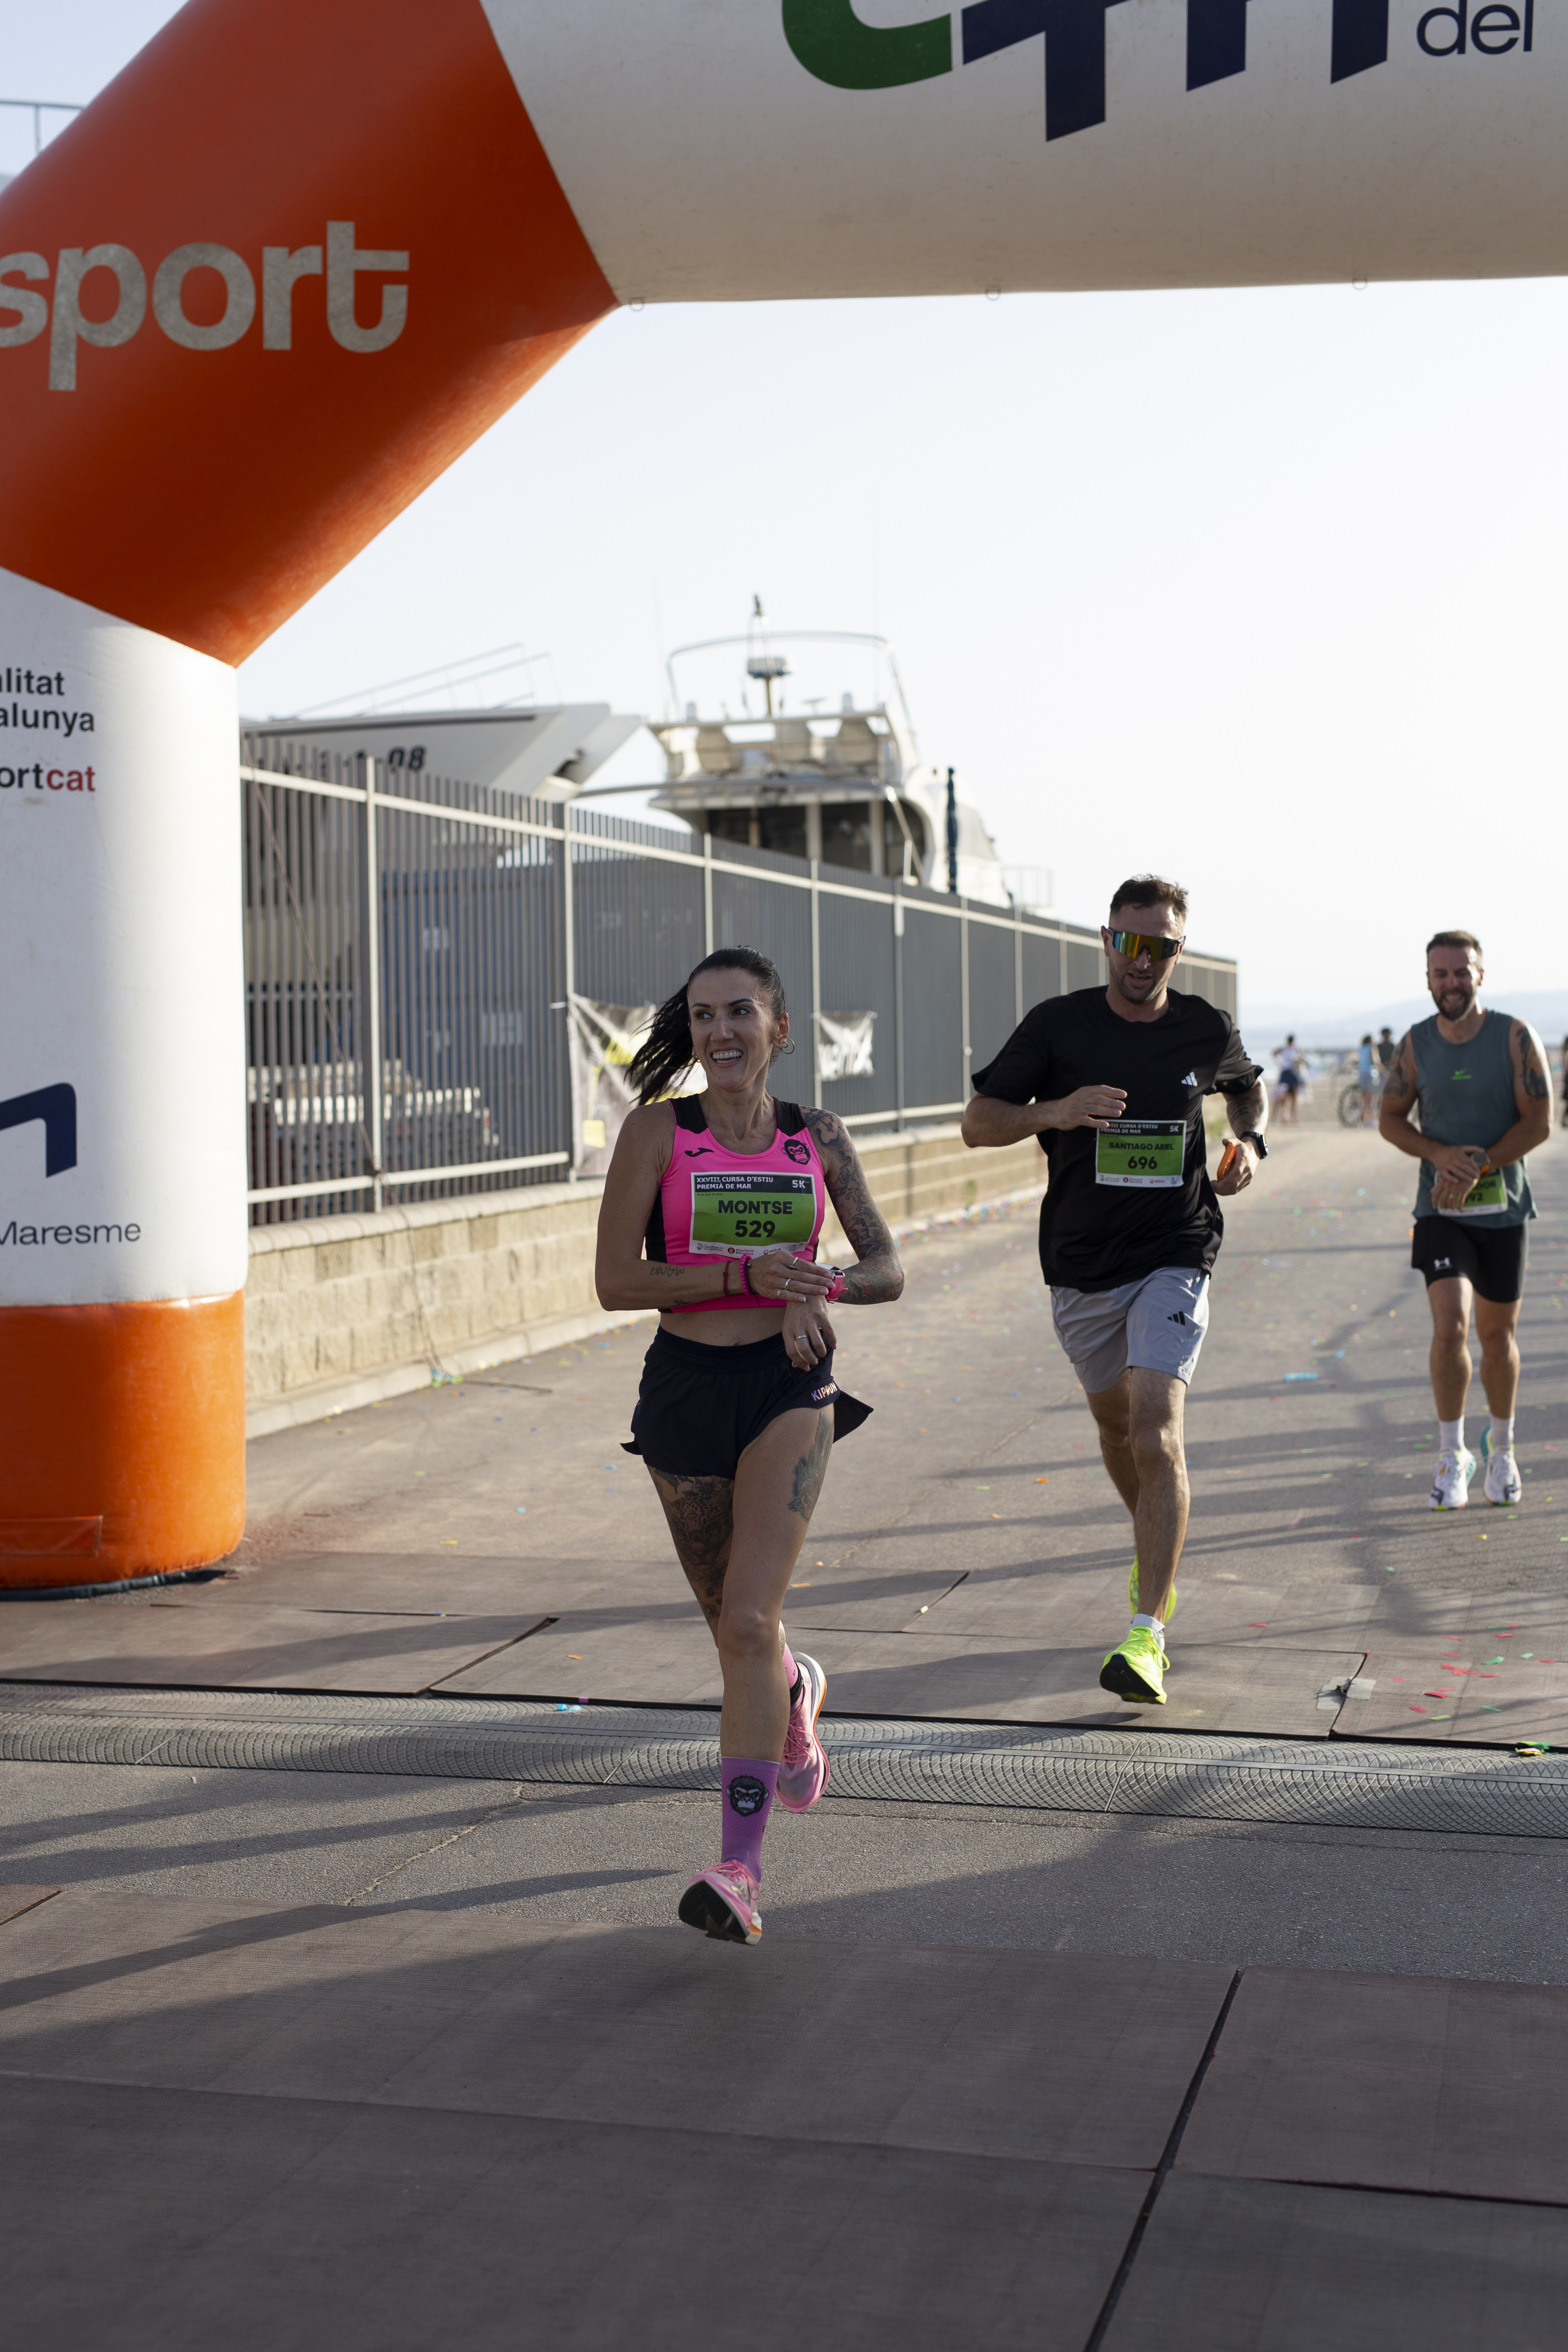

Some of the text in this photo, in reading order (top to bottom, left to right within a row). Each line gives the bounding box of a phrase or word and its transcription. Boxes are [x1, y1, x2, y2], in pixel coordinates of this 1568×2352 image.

[1416, 0, 1535, 56] del
[0, 220, 410, 392] sport
[0, 668, 65, 695] litat
[1109, 1142, 1153, 1150] SANTIAGO
[1127, 1156, 1158, 1170] 696
[792, 1180, 806, 1188] 5K
[718, 1200, 793, 1215] MONTSE
[735, 1220, 775, 1238] 529
[811, 1382, 838, 1401] KIPRUN
